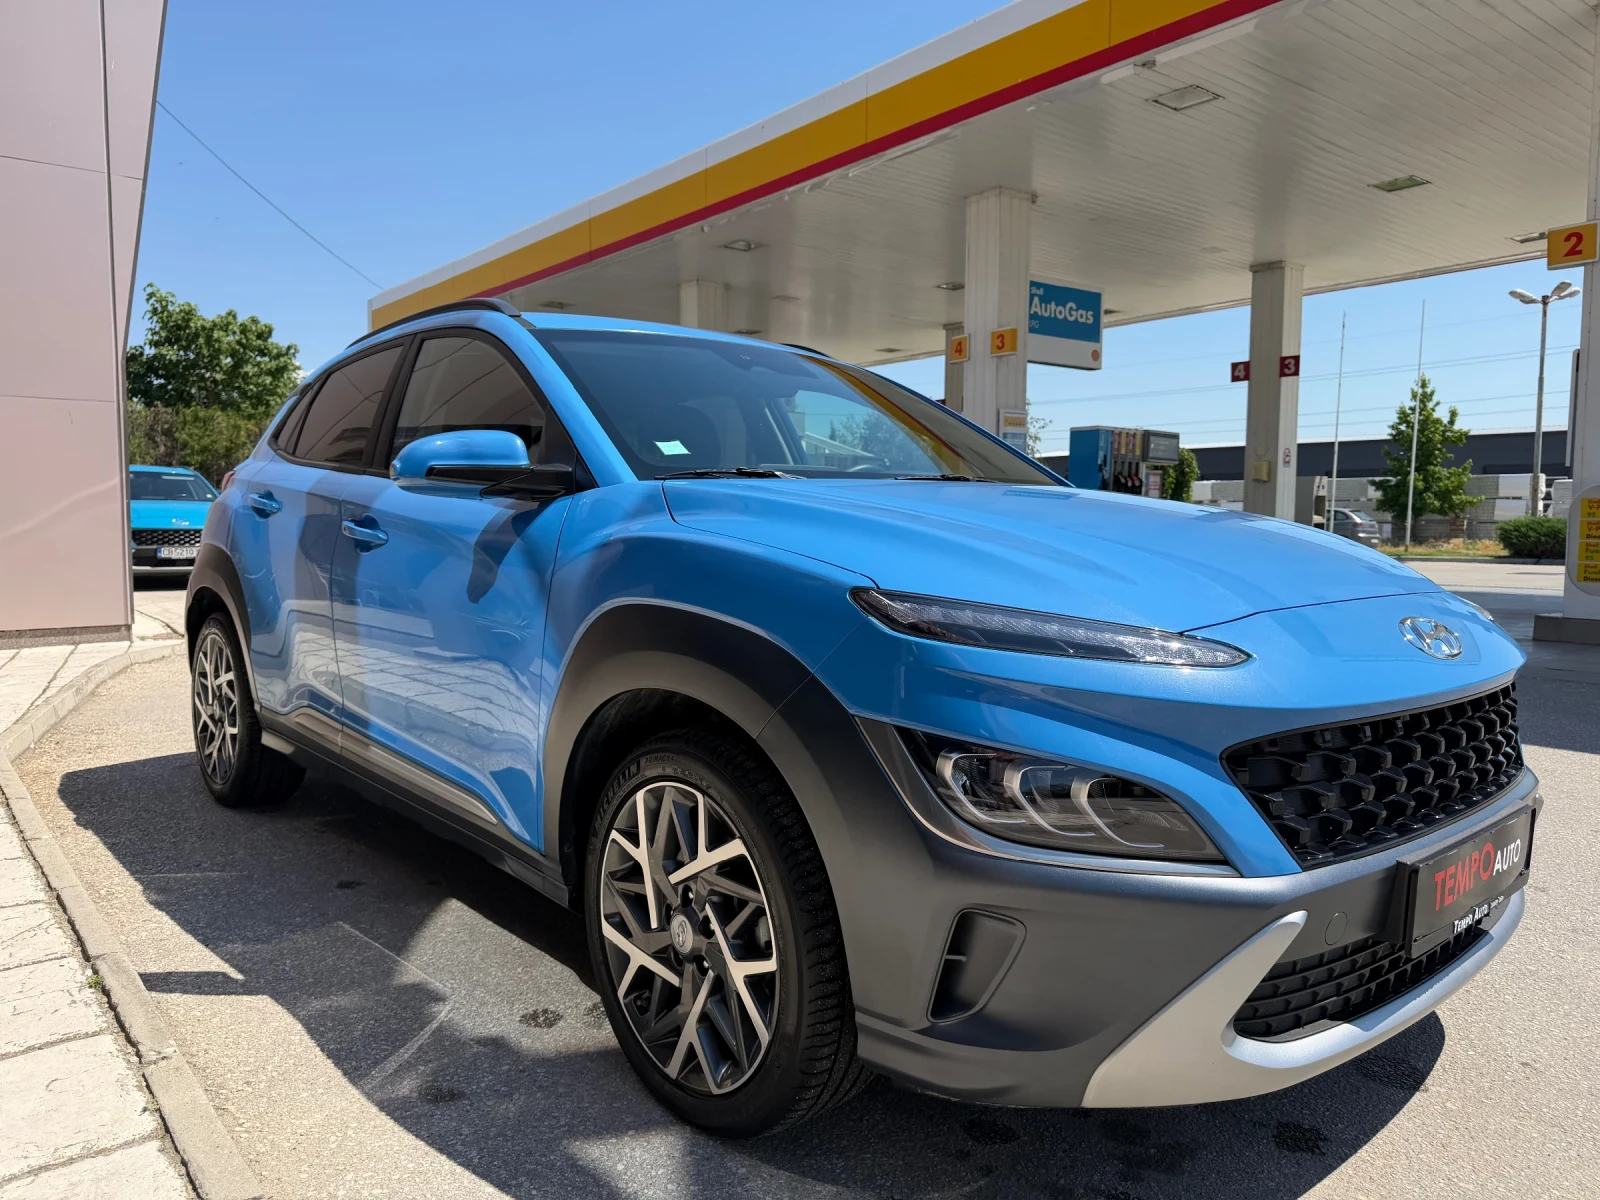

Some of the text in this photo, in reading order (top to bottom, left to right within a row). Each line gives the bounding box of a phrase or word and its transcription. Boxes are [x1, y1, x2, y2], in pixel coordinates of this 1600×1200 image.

[1563, 231, 1584, 258] 2
[1030, 286, 1044, 296] Shell
[1030, 296, 1094, 325] AutoGas
[954, 340, 963, 356] 4
[996, 333, 1005, 351] 3
[1234, 363, 1245, 379] 4
[1283, 358, 1296, 374] 3
[594, 761, 638, 832] MICHELIN
